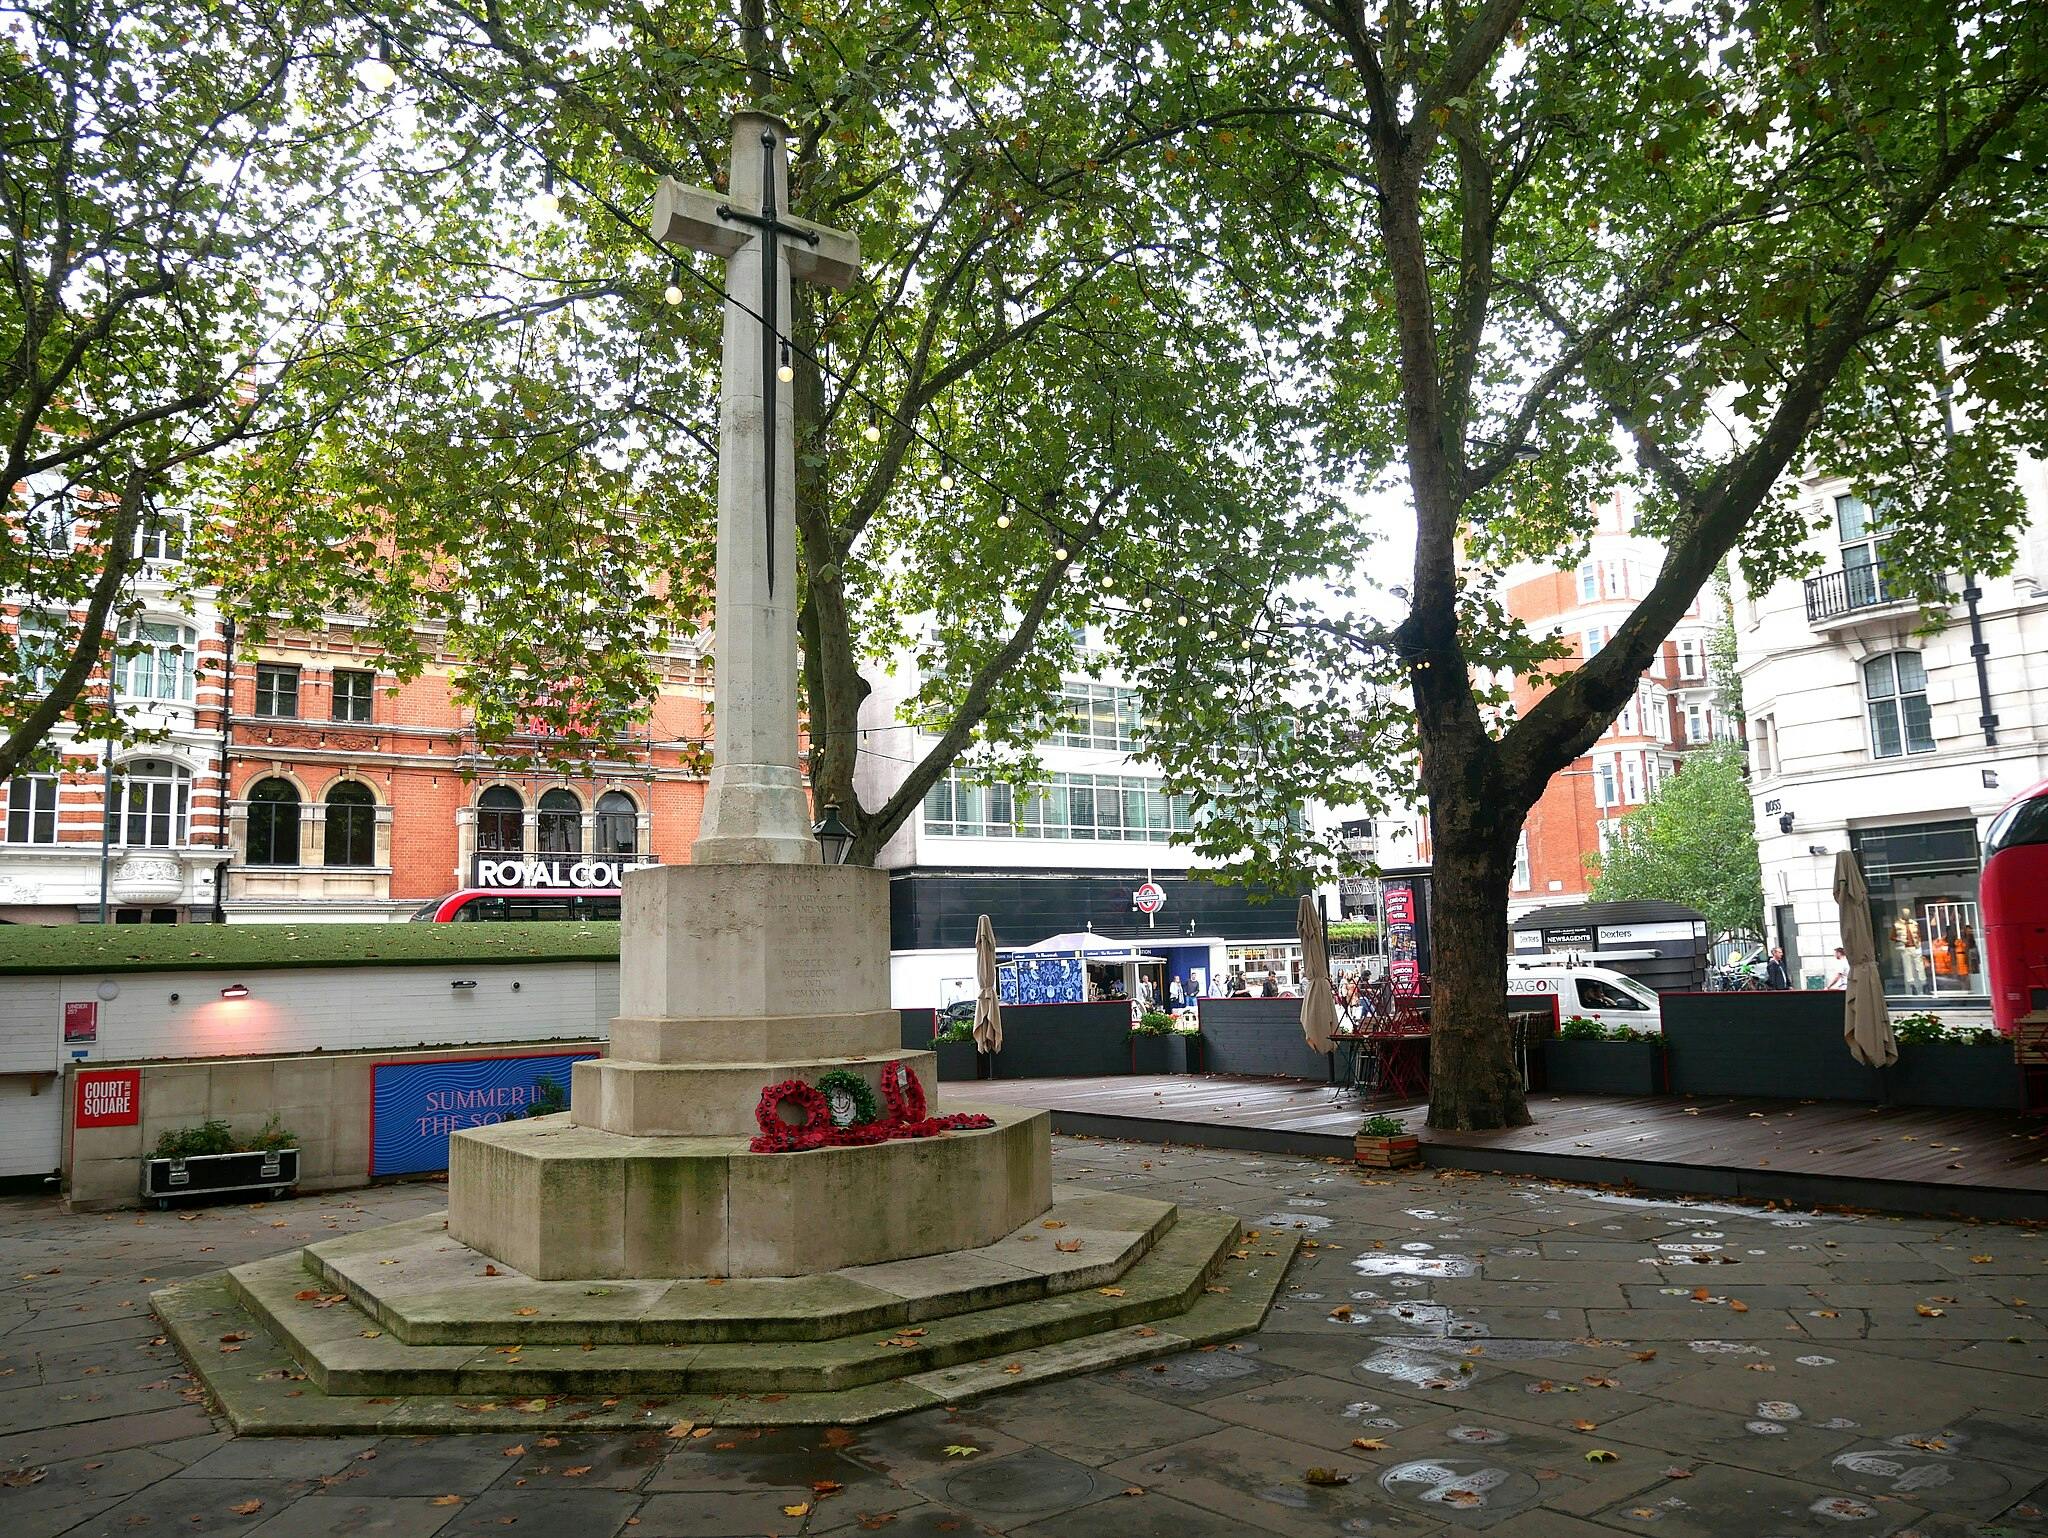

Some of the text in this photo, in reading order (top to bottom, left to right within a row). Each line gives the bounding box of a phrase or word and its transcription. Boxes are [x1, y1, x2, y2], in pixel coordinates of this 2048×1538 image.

[478, 860, 666, 888] ROYAL COU
[1547, 934, 1591, 943] NEWSAGENTS
[1600, 930, 1632, 939] Dexters
[85, 1081, 124, 1099] COURT
[426, 1086, 525, 1112] SUMMER
[84, 1096, 131, 1117] SQUARE
[415, 1114, 463, 1137] THE
